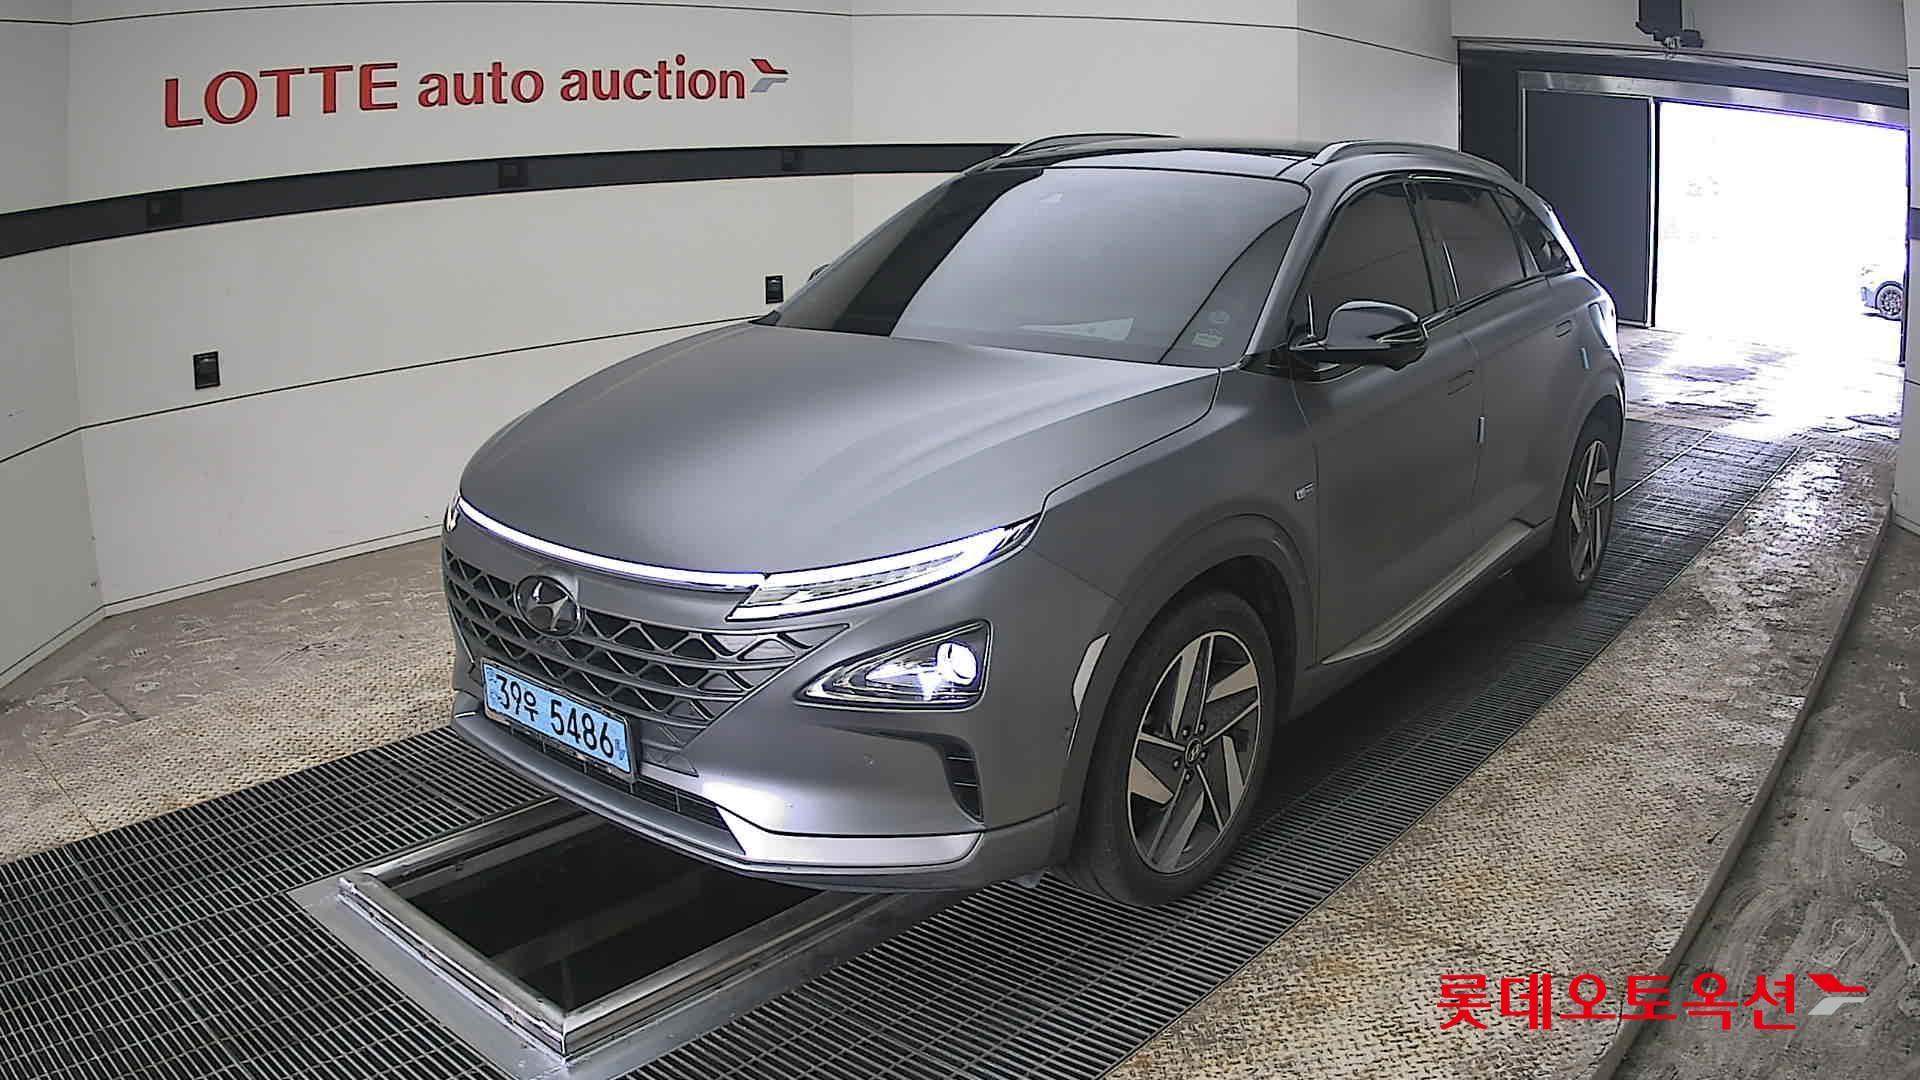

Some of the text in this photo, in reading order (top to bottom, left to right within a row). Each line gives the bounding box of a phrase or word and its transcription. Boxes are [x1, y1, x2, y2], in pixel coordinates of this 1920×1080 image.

[163, 54, 747, 129] LOTTE auto auction
[550, 699, 615, 759] 5486
